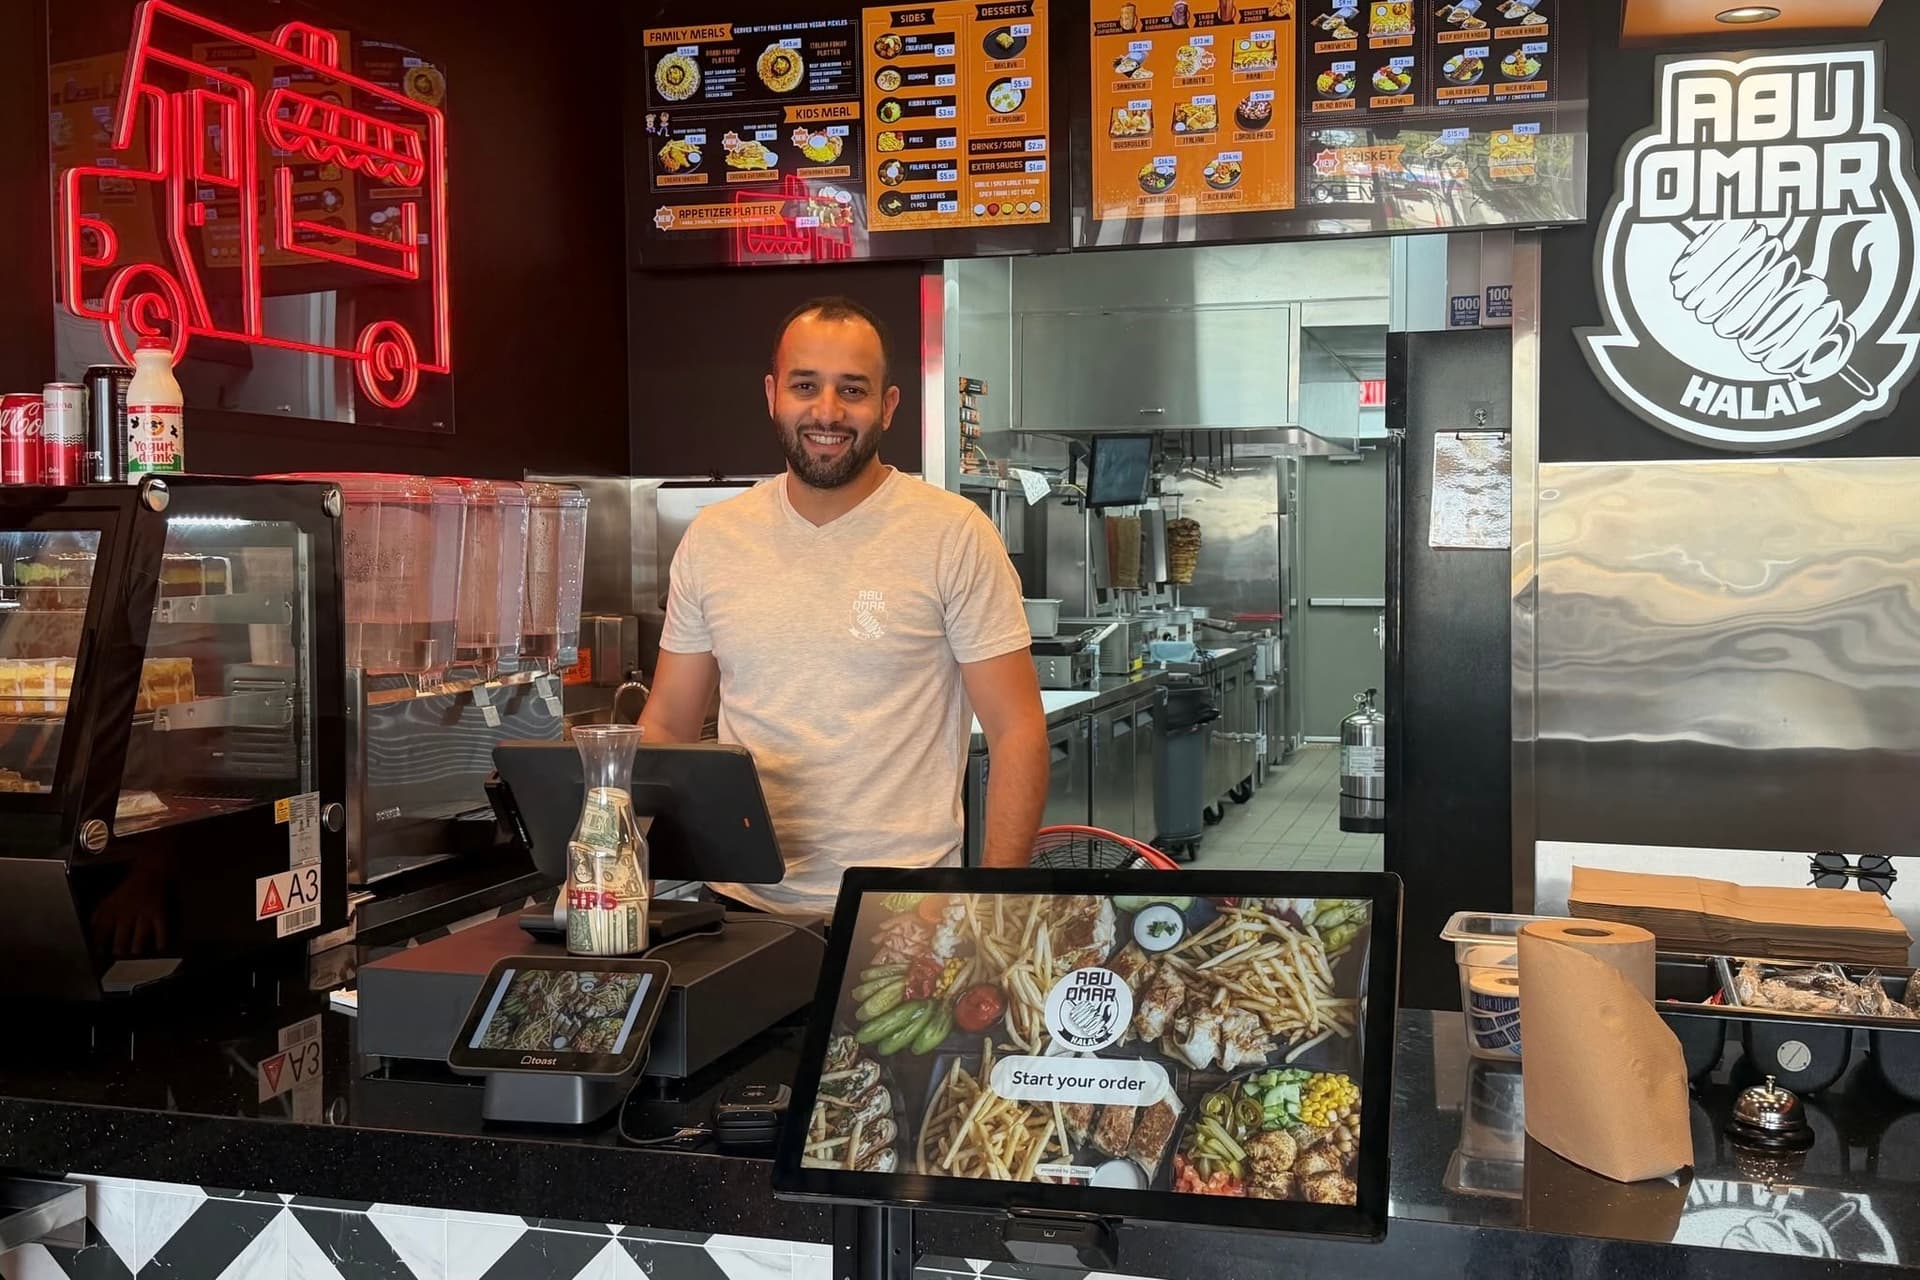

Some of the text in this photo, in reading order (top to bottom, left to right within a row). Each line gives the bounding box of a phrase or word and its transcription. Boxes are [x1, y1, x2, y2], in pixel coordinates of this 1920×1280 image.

[981, 5, 1028, 16] DESSERTS
[900, 14, 926, 24] SIDES
[650, 28, 725, 42] FAMILY MEALS
[1320, 42, 1350, 50] SANDWICH
[1116, 82, 1146, 90] SANDWICH
[796, 106, 852, 119] KIDS MEAL
[1677, 69, 1855, 144] ABU
[972, 142, 997, 150] DRINKS
[1003, 140, 1022, 149] SODA
[972, 160, 1024, 171] EXTRA SAUCES
[1639, 141, 1879, 218] OMAR
[679, 205, 776, 219] APPETIZER PLATTER
[1453, 298, 1480, 310] 1000
[1360, 382, 1385, 404] XIT
[1680, 374, 1821, 420] HALAL
[135, 440, 175, 452] Yogurt
[139, 452, 173, 462] drink
[859, 590, 883, 600] ABU
[852, 600, 886, 612] OMAR
[287, 870, 318, 908] A3
[1076, 972, 1113, 986] ABU
[1066, 987, 1116, 1002] OMAR
[1071, 1036, 1098, 1046] HALAL
[532, 1057, 557, 1065] toast
[1012, 1070, 1146, 1090] Start your order
